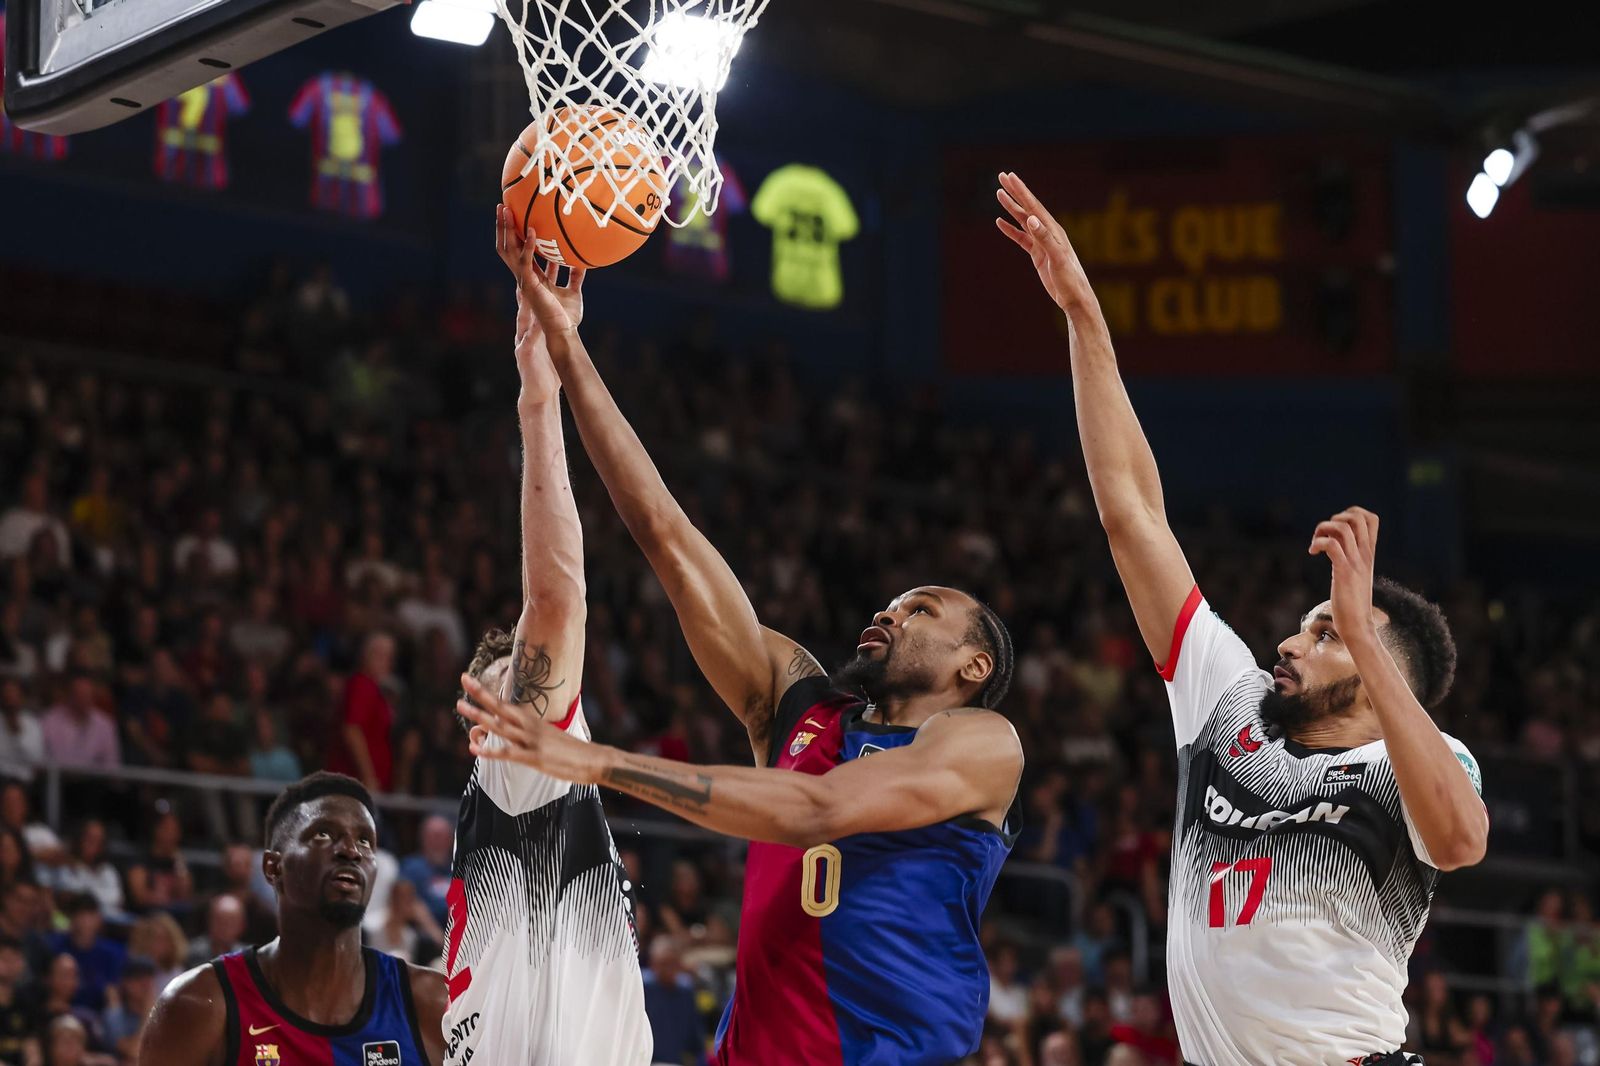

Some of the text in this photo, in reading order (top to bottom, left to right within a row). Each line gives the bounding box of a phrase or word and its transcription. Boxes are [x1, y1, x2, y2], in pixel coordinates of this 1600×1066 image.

[1173, 204, 1280, 273] QUE
[1148, 277, 1280, 332] CLUB
[801, 844, 842, 917] 0
[1209, 857, 1272, 928] 17
